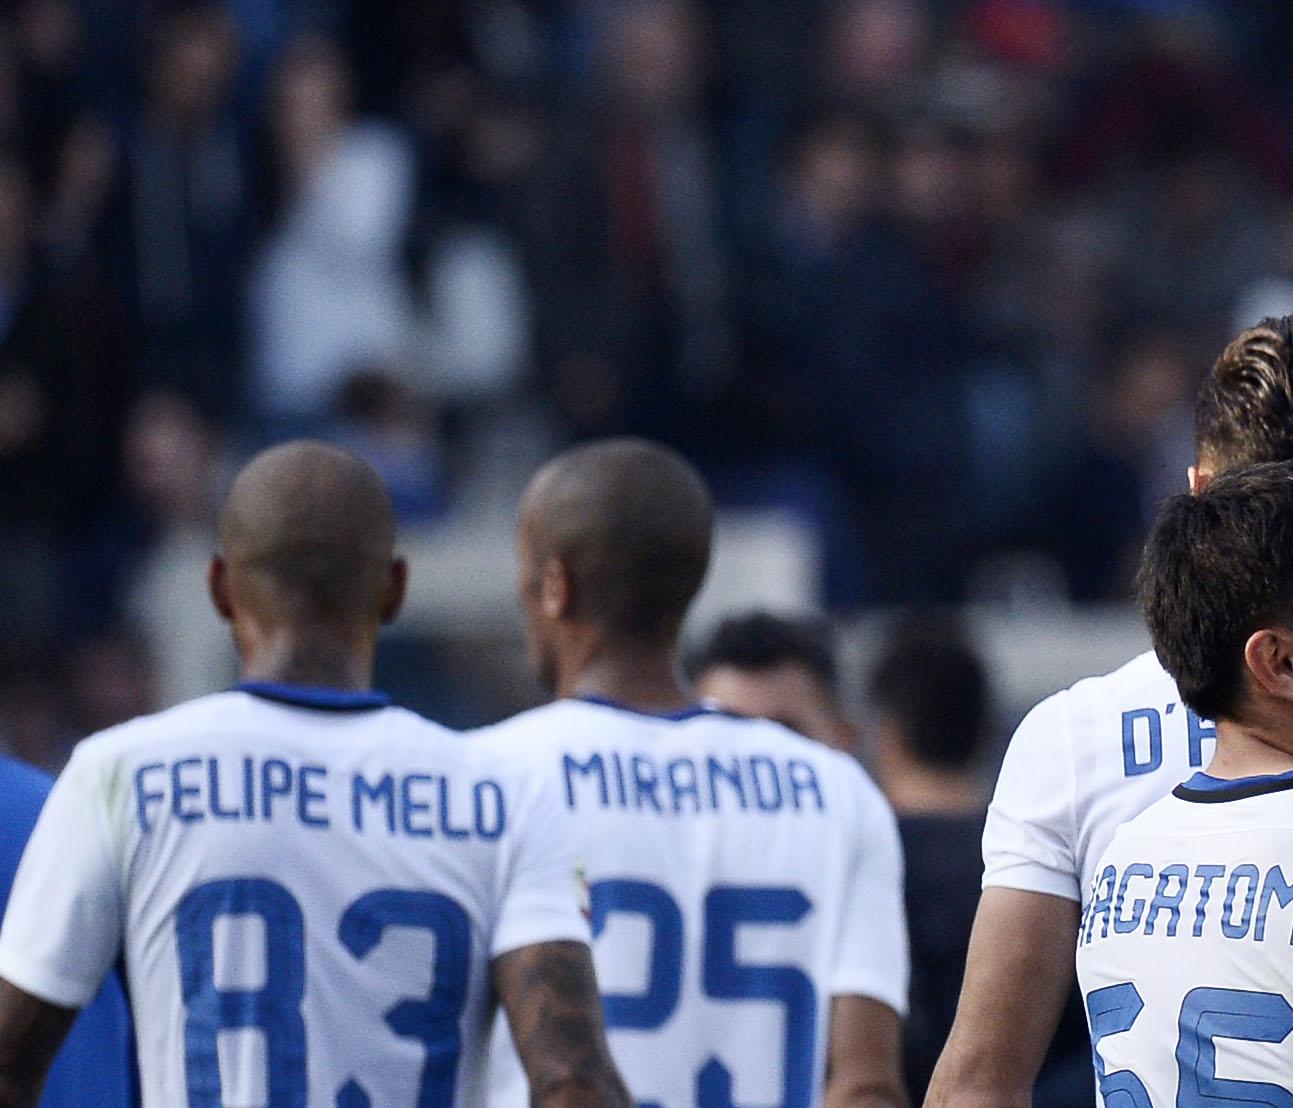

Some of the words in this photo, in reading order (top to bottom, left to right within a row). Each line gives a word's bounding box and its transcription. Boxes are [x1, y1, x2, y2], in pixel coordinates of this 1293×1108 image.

[134, 756, 329, 836] FELIPE
[351, 773, 508, 842] MELO
[563, 751, 826, 815] MIRANDA
